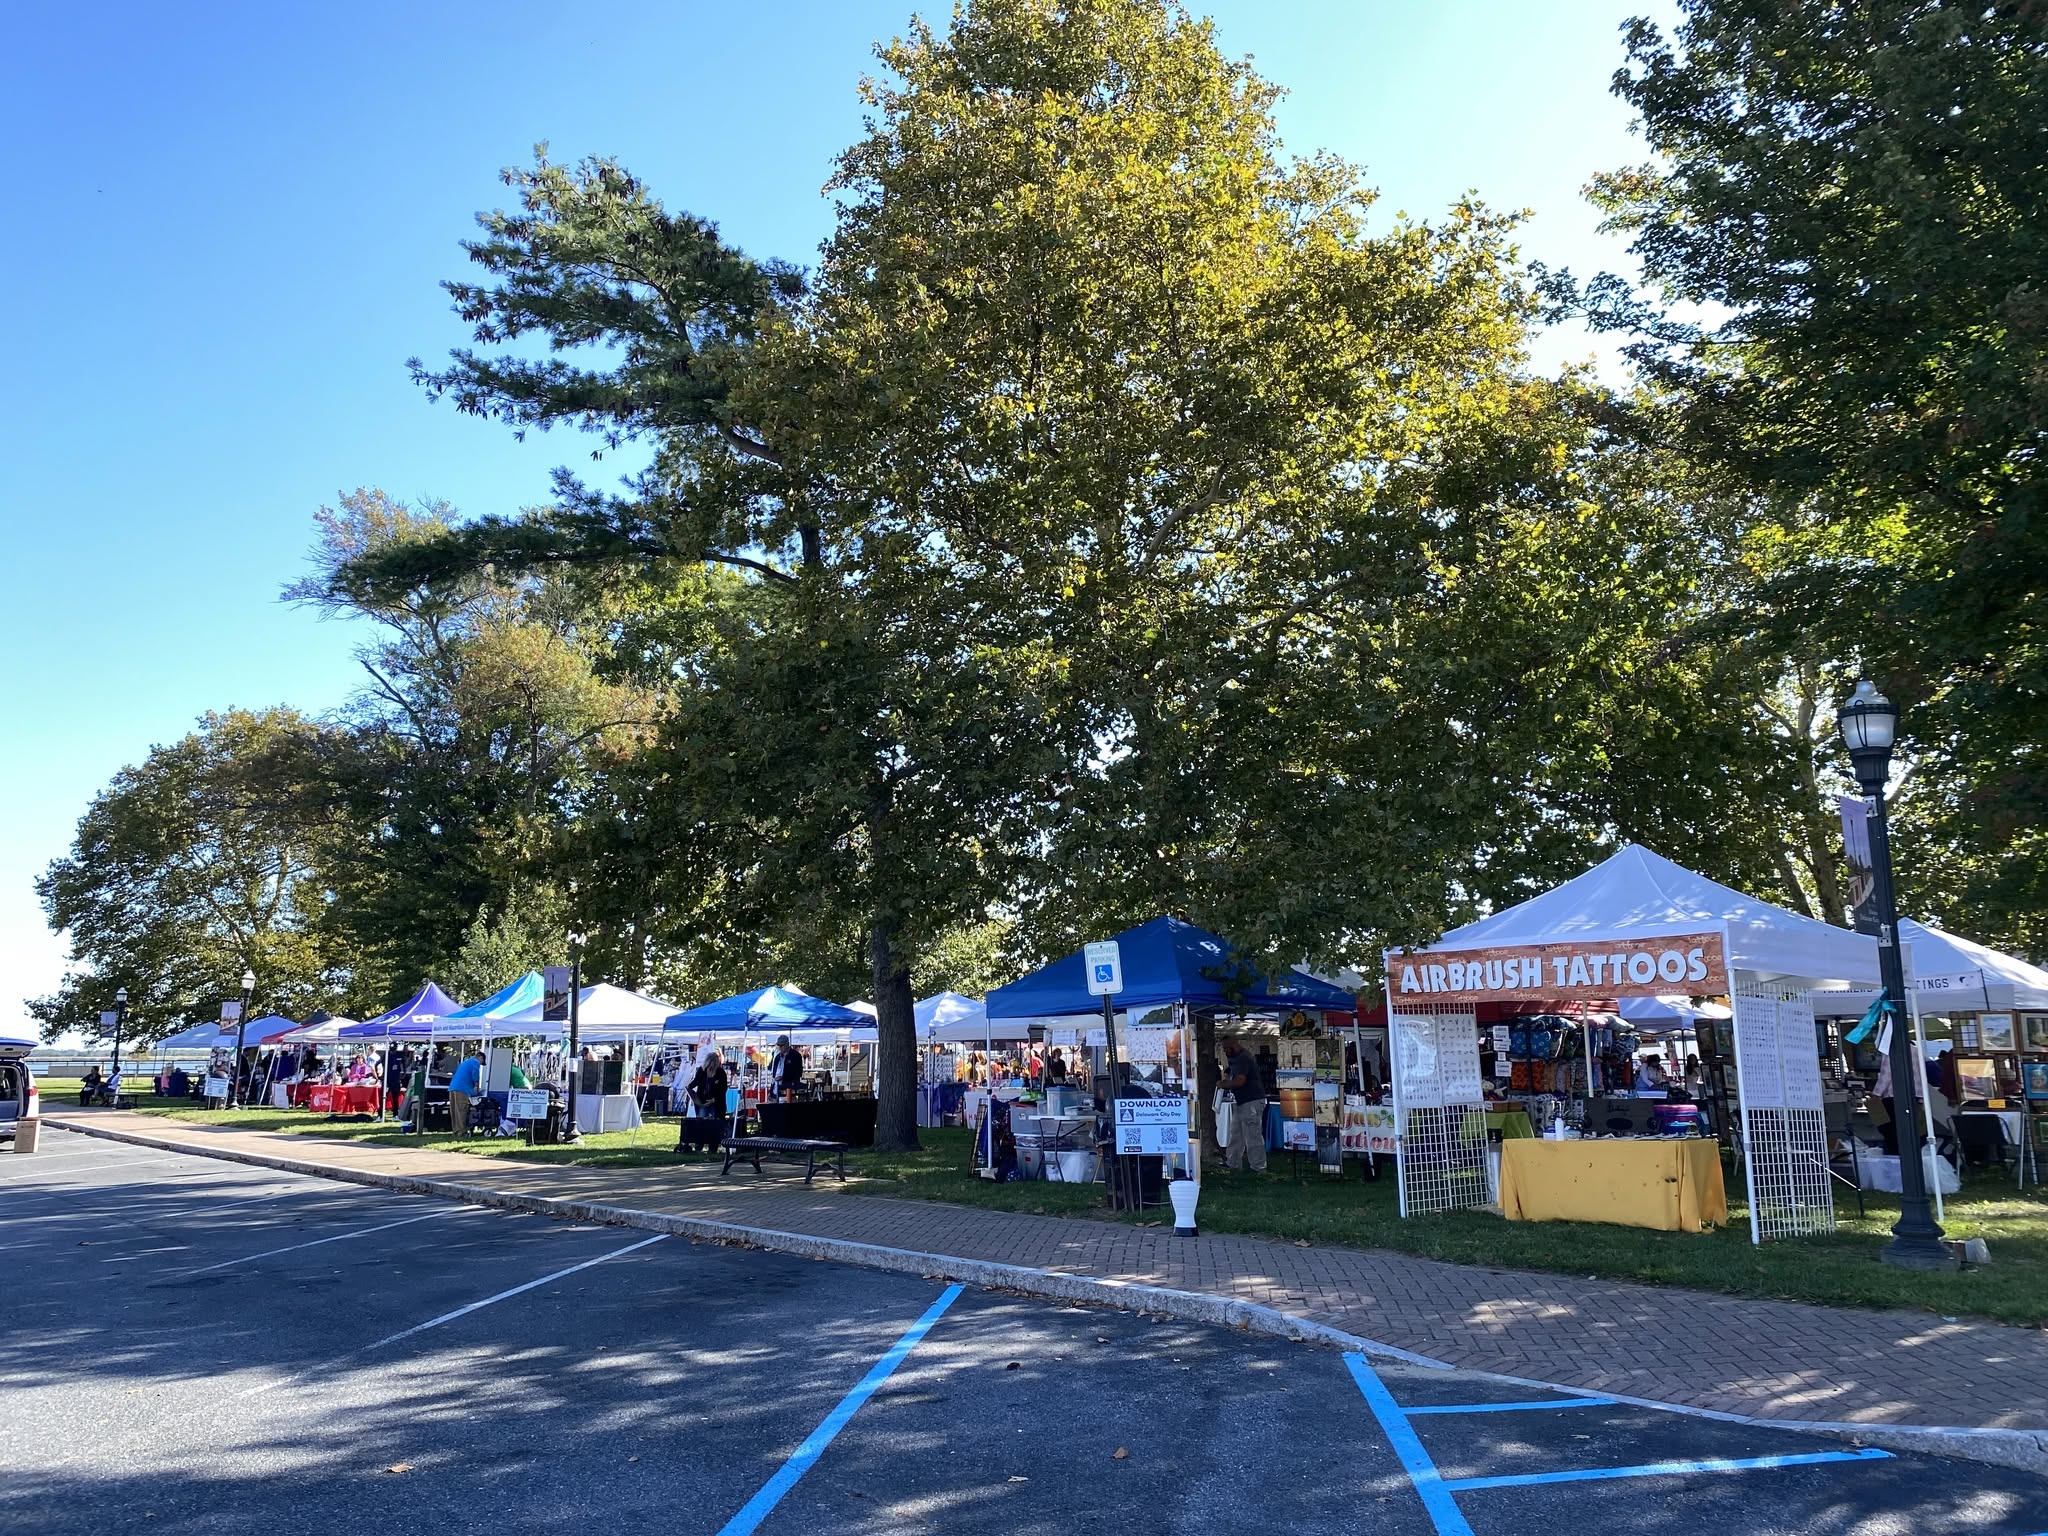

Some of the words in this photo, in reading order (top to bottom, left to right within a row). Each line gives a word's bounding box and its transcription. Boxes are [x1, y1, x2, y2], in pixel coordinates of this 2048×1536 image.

[1088, 945, 1117, 956] RESERVED
[1090, 954, 1116, 963] PARKING
[1401, 957, 1543, 993] AIRBRUSH
[1553, 948, 1709, 987] TATTOOS
[1120, 1100, 1182, 1108] DOWNLOAD
